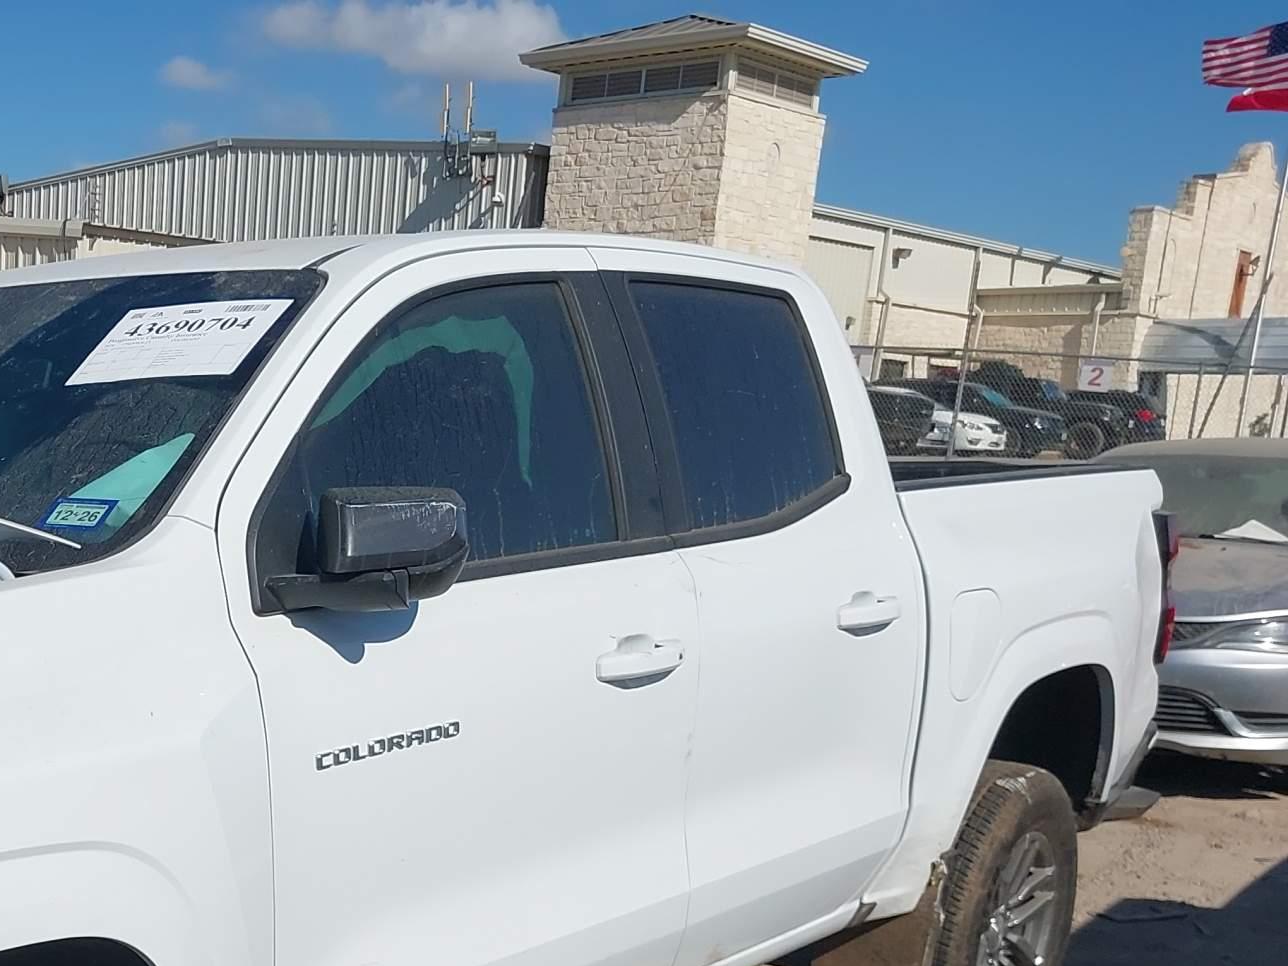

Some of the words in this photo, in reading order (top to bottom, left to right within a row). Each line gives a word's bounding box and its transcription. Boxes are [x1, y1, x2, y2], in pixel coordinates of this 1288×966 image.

[124, 315, 257, 337] 43690704
[1087, 367, 1105, 387] 2
[315, 720, 460, 770] COLORADO
